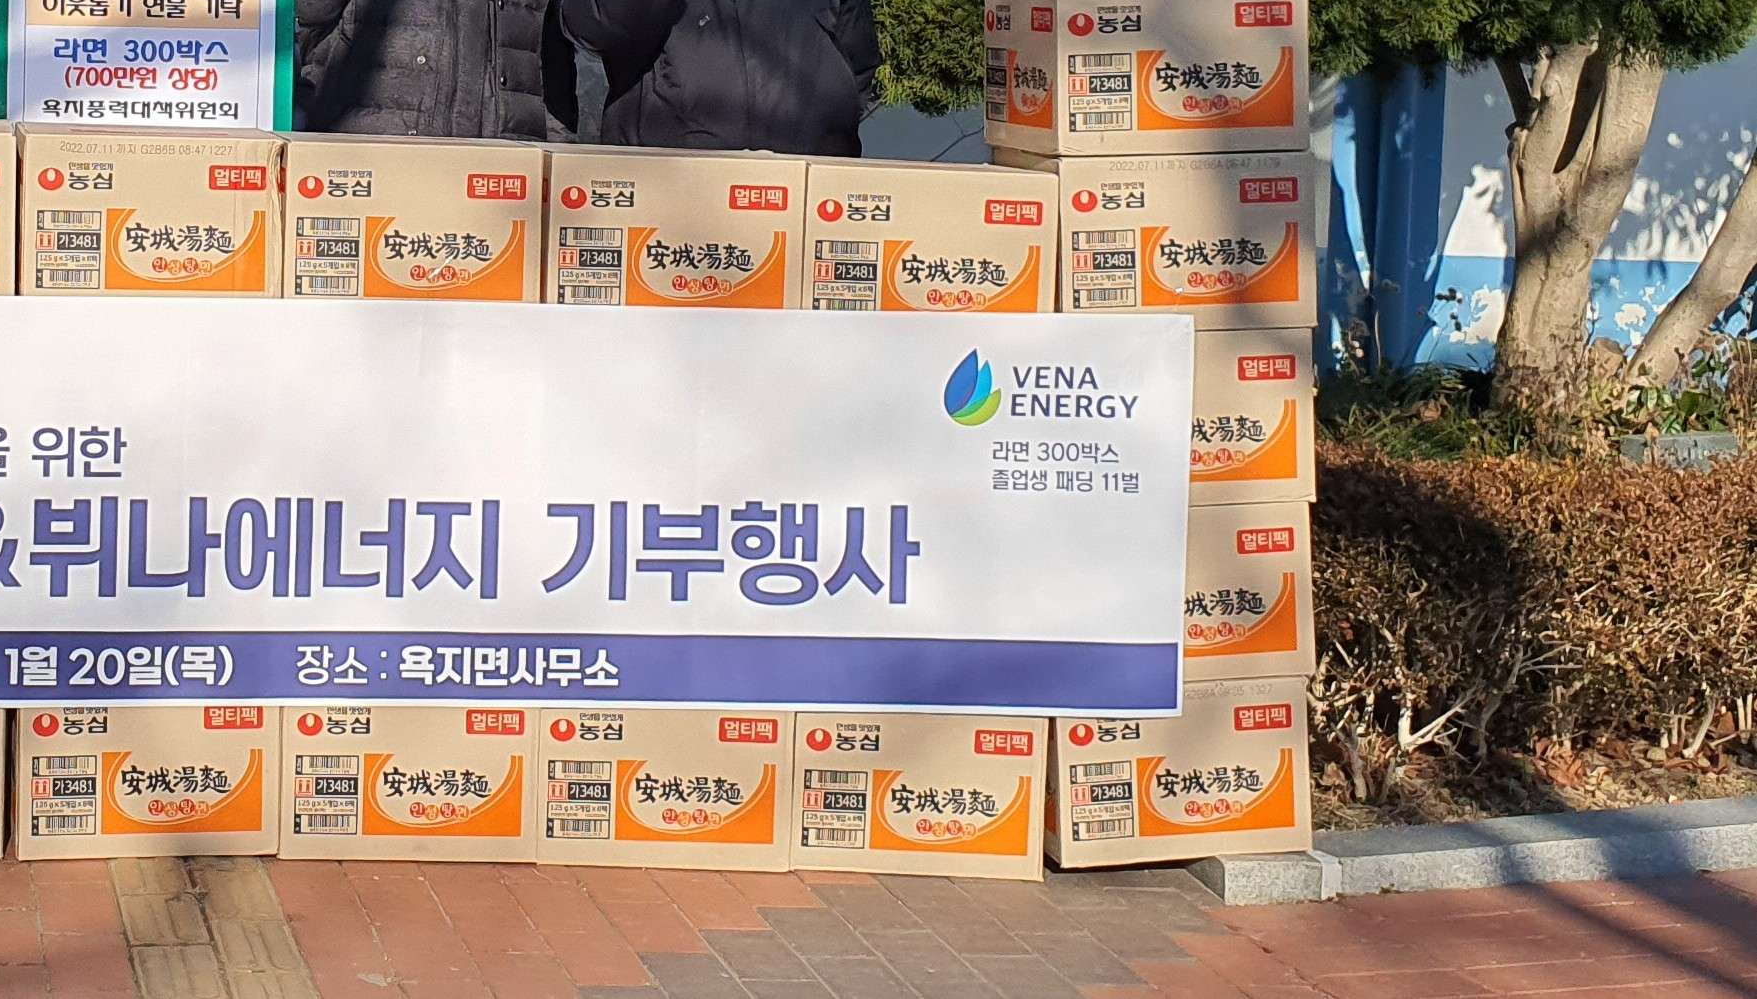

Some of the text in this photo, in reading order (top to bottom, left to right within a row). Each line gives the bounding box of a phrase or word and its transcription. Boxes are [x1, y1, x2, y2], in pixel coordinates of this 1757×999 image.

[1240, 3, 1289, 24] 멀티팩
[1097, 14, 1141, 34] 농심
[54, 37, 229, 65] 라면 300박스
[65, 66, 218, 91] (700만원 상당)
[1090, 77, 1129, 92] 가3481
[42, 99, 239, 121] 욕지풍력대책위원회
[67, 171, 113, 190] 농심
[214, 168, 264, 187] 멀티팩
[472, 177, 522, 196] 멀티팩
[326, 179, 372, 197] 농심
[734, 188, 784, 207] 멀티팩
[1245, 180, 1294, 200] 멀티팩
[589, 189, 635, 208] 농심
[1100, 190, 1145, 210] 농심
[845, 203, 891, 222] 농심
[989, 202, 1039, 222] 멀티팩
[58, 235, 99, 248] 가3481
[317, 242, 357, 256] 가3481
[580, 252, 620, 266] 가3481
[1094, 254, 1133, 268] 가3481
[835, 265, 875, 279] 가3481
[1012, 366, 1099, 389] VENA
[1242, 357, 1291, 378] 멀티팩
[1010, 394, 1138, 418] ENERGY
[31, 425, 127, 478] 위한
[992, 441, 1119, 464] 라면 300박스
[992, 469, 1140, 493] 졸업생 패딩 11벌
[1241, 529, 1289, 551] 멀티팩
[543, 501, 921, 606] 기부행사
[1185, 587, 1264, 619] 城湯麵
[5, 645, 58, 687] 1월
[69, 645, 235, 687] 20일(목)
[295, 645, 369, 686] 장소
[399, 645, 620, 687] 욕지면사무소
[62, 715, 108, 735] 농심
[209, 706, 259, 726] 멀티팩
[325, 716, 371, 734] 농심
[471, 712, 521, 731] 멀티팩
[1239, 706, 1287, 728] 멀티팩
[578, 722, 624, 741] 농심
[723, 720, 773, 740] 멀티팩
[1096, 721, 1141, 743] 농심
[834, 732, 880, 751] 농심
[979, 733, 1029, 753] 멀티팩
[54, 780, 94, 794] 가3481
[316, 780, 356, 793] 가3481
[569, 785, 609, 799] 가3481
[1092, 785, 1130, 801] 가3481
[824, 795, 864, 809] 가3481
